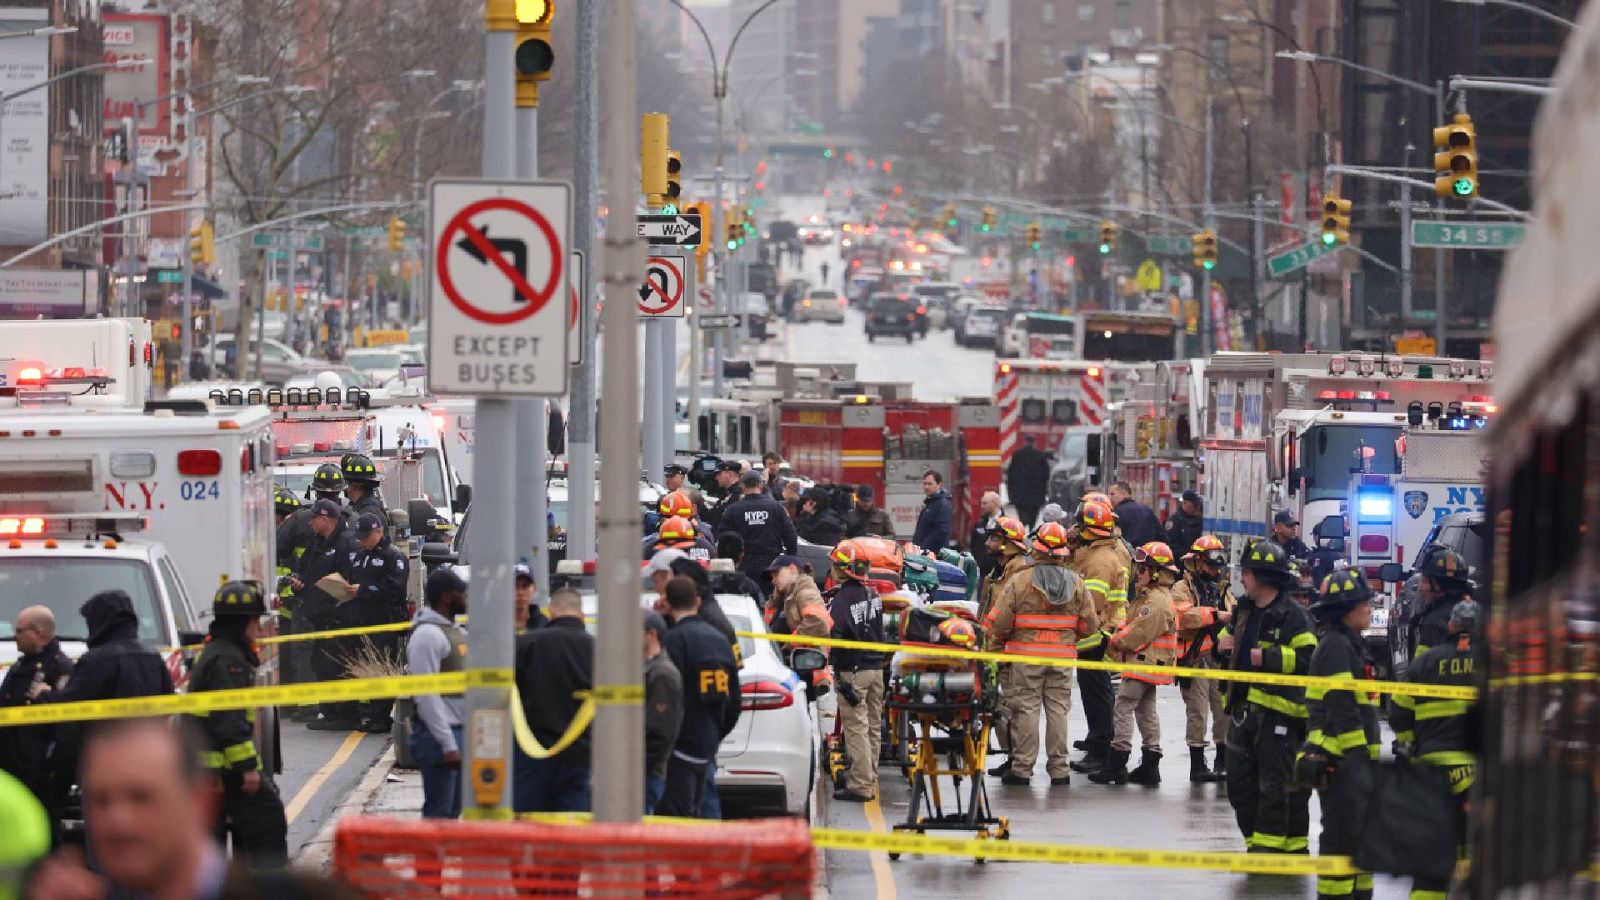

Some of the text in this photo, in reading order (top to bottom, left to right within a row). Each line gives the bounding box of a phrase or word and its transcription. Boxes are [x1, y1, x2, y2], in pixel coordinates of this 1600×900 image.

[102, 30, 132, 41] VICE
[662, 225, 691, 237] WAY
[1441, 227, 1467, 242] 34
[454, 334, 541, 356] EXCEPT
[458, 363, 537, 384] BUSES
[103, 481, 165, 511] N.Y.
[181, 480, 220, 501] 024
[545, 541, 566, 551] DNY
